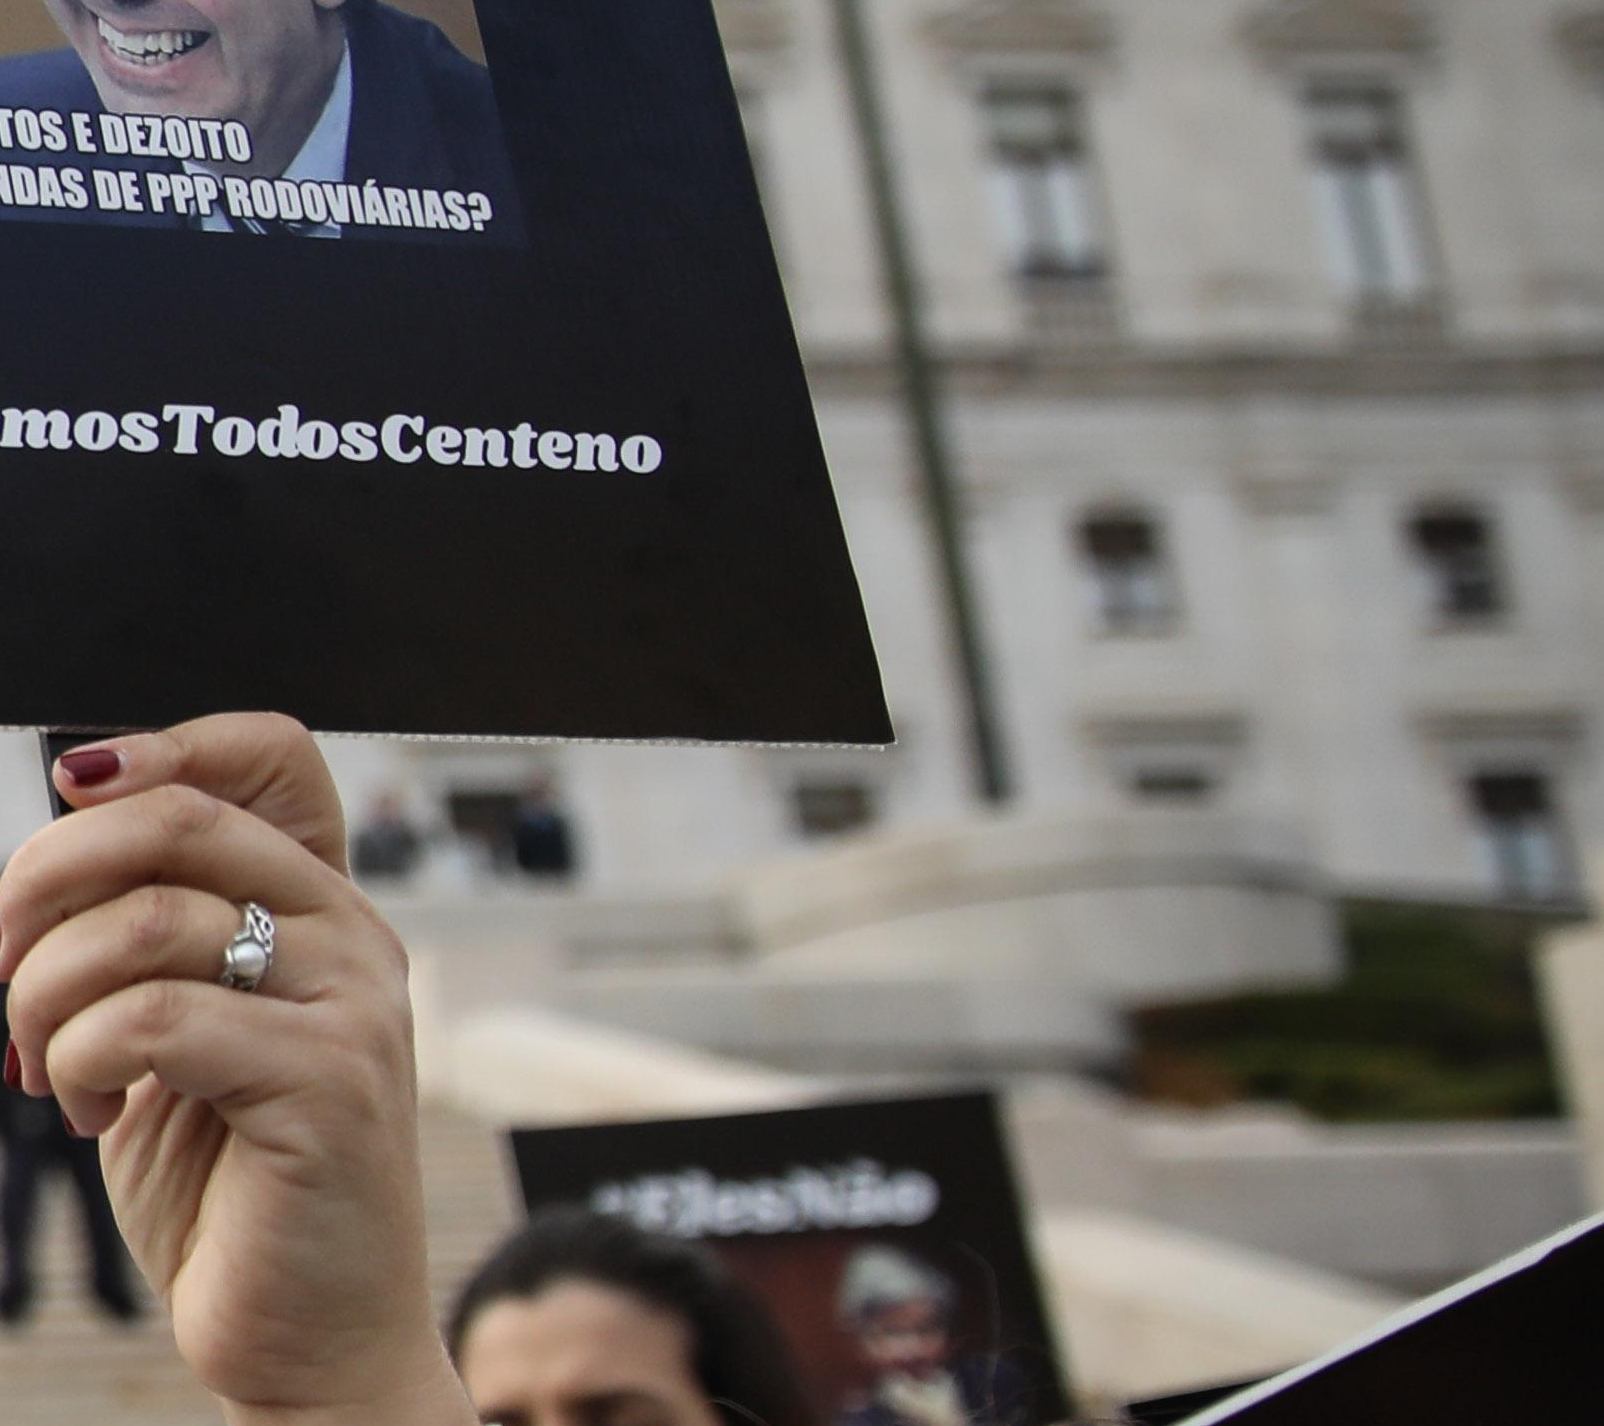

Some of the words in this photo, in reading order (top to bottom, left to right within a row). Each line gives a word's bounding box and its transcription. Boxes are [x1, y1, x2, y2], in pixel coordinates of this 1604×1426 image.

[71, 113, 97, 153] E
[99, 115, 251, 162] DEZOITO
[91, 170, 144, 213] DE
[147, 173, 219, 216] PPP
[223, 177, 493, 232] RODOVIÁRIAS?
